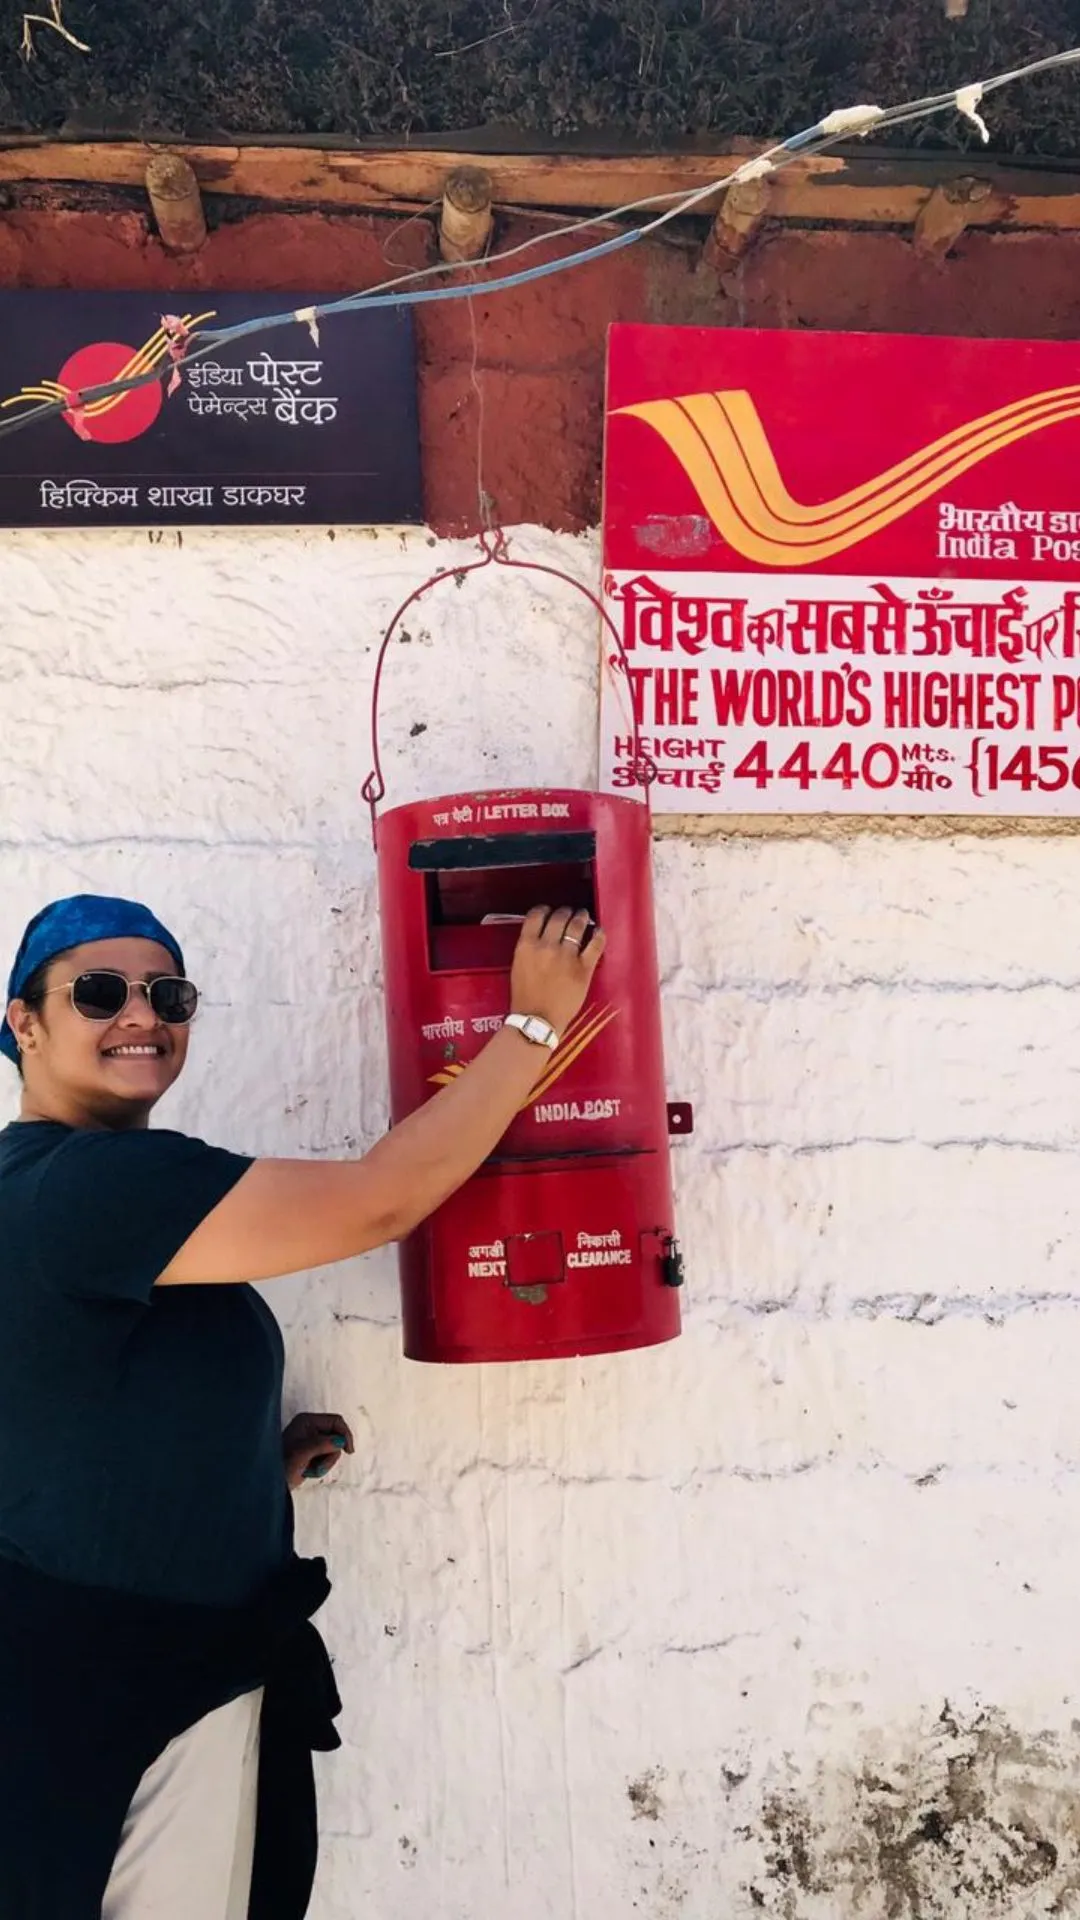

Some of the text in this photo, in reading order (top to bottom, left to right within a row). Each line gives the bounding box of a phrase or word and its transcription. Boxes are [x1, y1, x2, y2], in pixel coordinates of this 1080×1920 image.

[186, 352, 323, 387] इंडिया पोस्ट
[187, 387, 338, 425] पेमेन्ट्स बैंक
[40, 480, 306, 508] हिक्किम शाखा डाकघर
[938, 501, 1080, 533] भारतीय डा
[936, 531, 1018, 560] India
[747, 608, 788, 656] का
[786, 582, 912, 656] सबसे
[1022, 609, 1063, 662] पर
[710, 662, 872, 728] WORLD'S
[884, 671, 1042, 731] HIGHEST
[1053, 675, 1080, 732] P
[614, 735, 726, 759] HEIGHT
[733, 740, 900, 790] 4440
[901, 743, 956, 763] Mts.
[484, 804, 539, 820] LETTER
[541, 803, 570, 818] BOX
[421, 1016, 465, 1040] भारतीय
[534, 1099, 621, 1123] INDIA POST
[468, 1260, 507, 1278] NEXT
[567, 1249, 632, 1268] CLEARANCE
